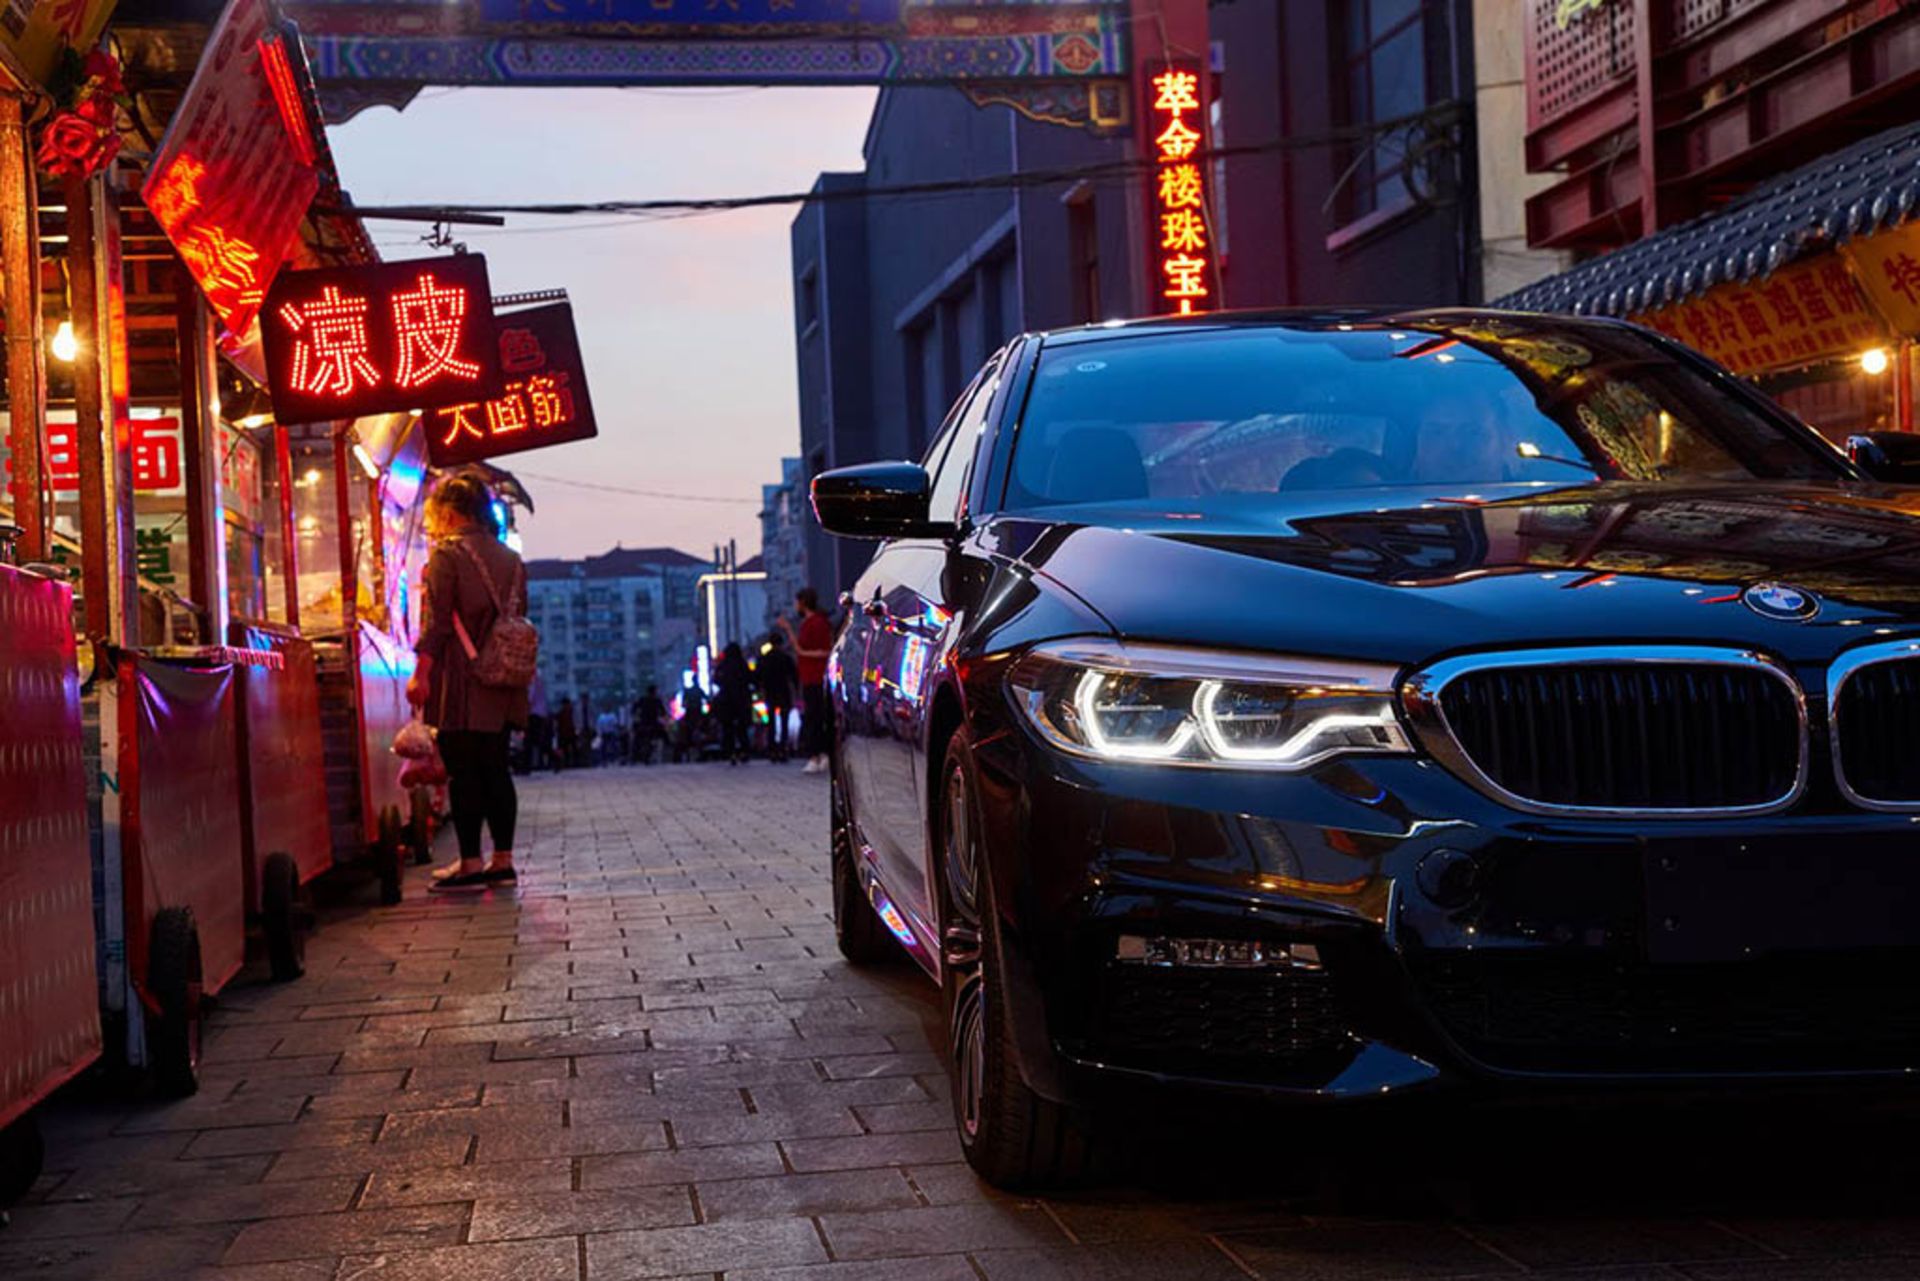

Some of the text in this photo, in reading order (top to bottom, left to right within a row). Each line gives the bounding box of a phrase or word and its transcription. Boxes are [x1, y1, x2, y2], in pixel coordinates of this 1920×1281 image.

[1153, 72, 1207, 315] 萃金楼珠宝
[279, 274, 480, 395] 凉皮
